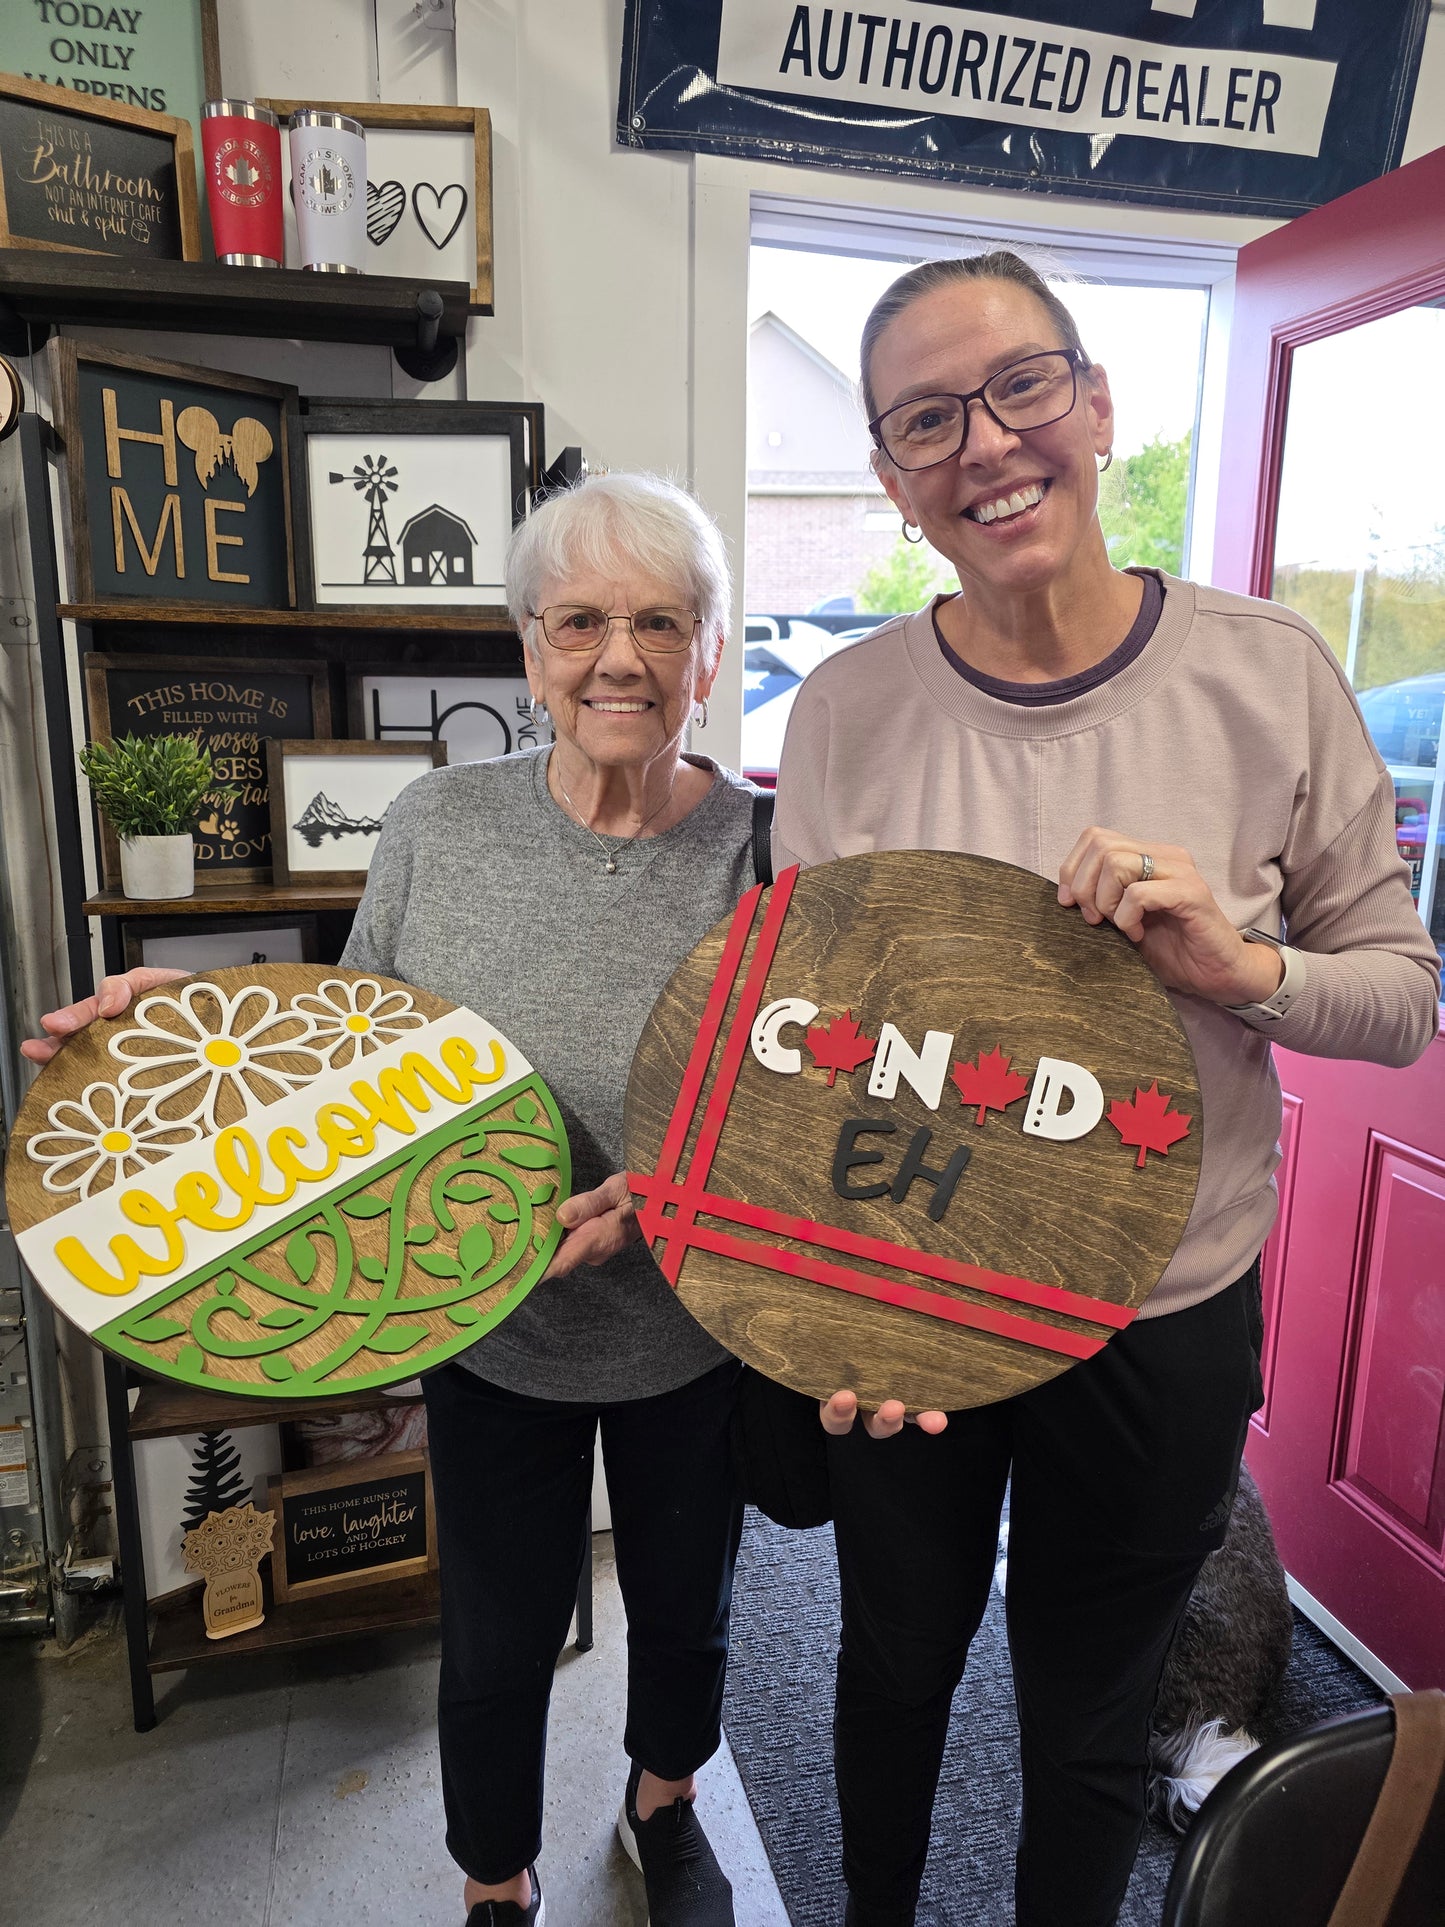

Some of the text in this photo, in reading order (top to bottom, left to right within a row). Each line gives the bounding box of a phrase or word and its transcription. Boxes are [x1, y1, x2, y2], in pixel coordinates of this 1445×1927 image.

[34, 0, 142, 34] TODAY
[51, 38, 135, 71] ONLY
[779, 4, 1282, 134] AUTHORIZED DEALER
[23, 72, 167, 112] PPENS
[37, 120, 93, 152] THIS IS A
[16, 141, 164, 201] Bathroom
[44, 185, 162, 224] NOT AN INTERNET CAFE
[48, 204, 75, 225] shit
[95, 216, 126, 241] split
[111, 486, 250, 584] ME
[127, 682, 288, 719] THIS HOME IS
[162, 711, 258, 724] FILLED WITH
[515, 696, 538, 751] OME
[209, 731, 272, 755] noses
[212, 757, 263, 780] SES
[241, 782, 269, 806] tai
[54, 1036, 506, 1297] welcome
[831, 1119, 971, 1222] EH
[302, 1488, 408, 1516] THIS HOME RUNS ON
[343, 1500, 418, 1539] laughter
[307, 1533, 407, 1562] LOTS OF HOCKEY
[346, 1533, 368, 1543] AND
[216, 1582, 251, 1597] FLOWERS
[213, 1600, 255, 1617] Grandma
